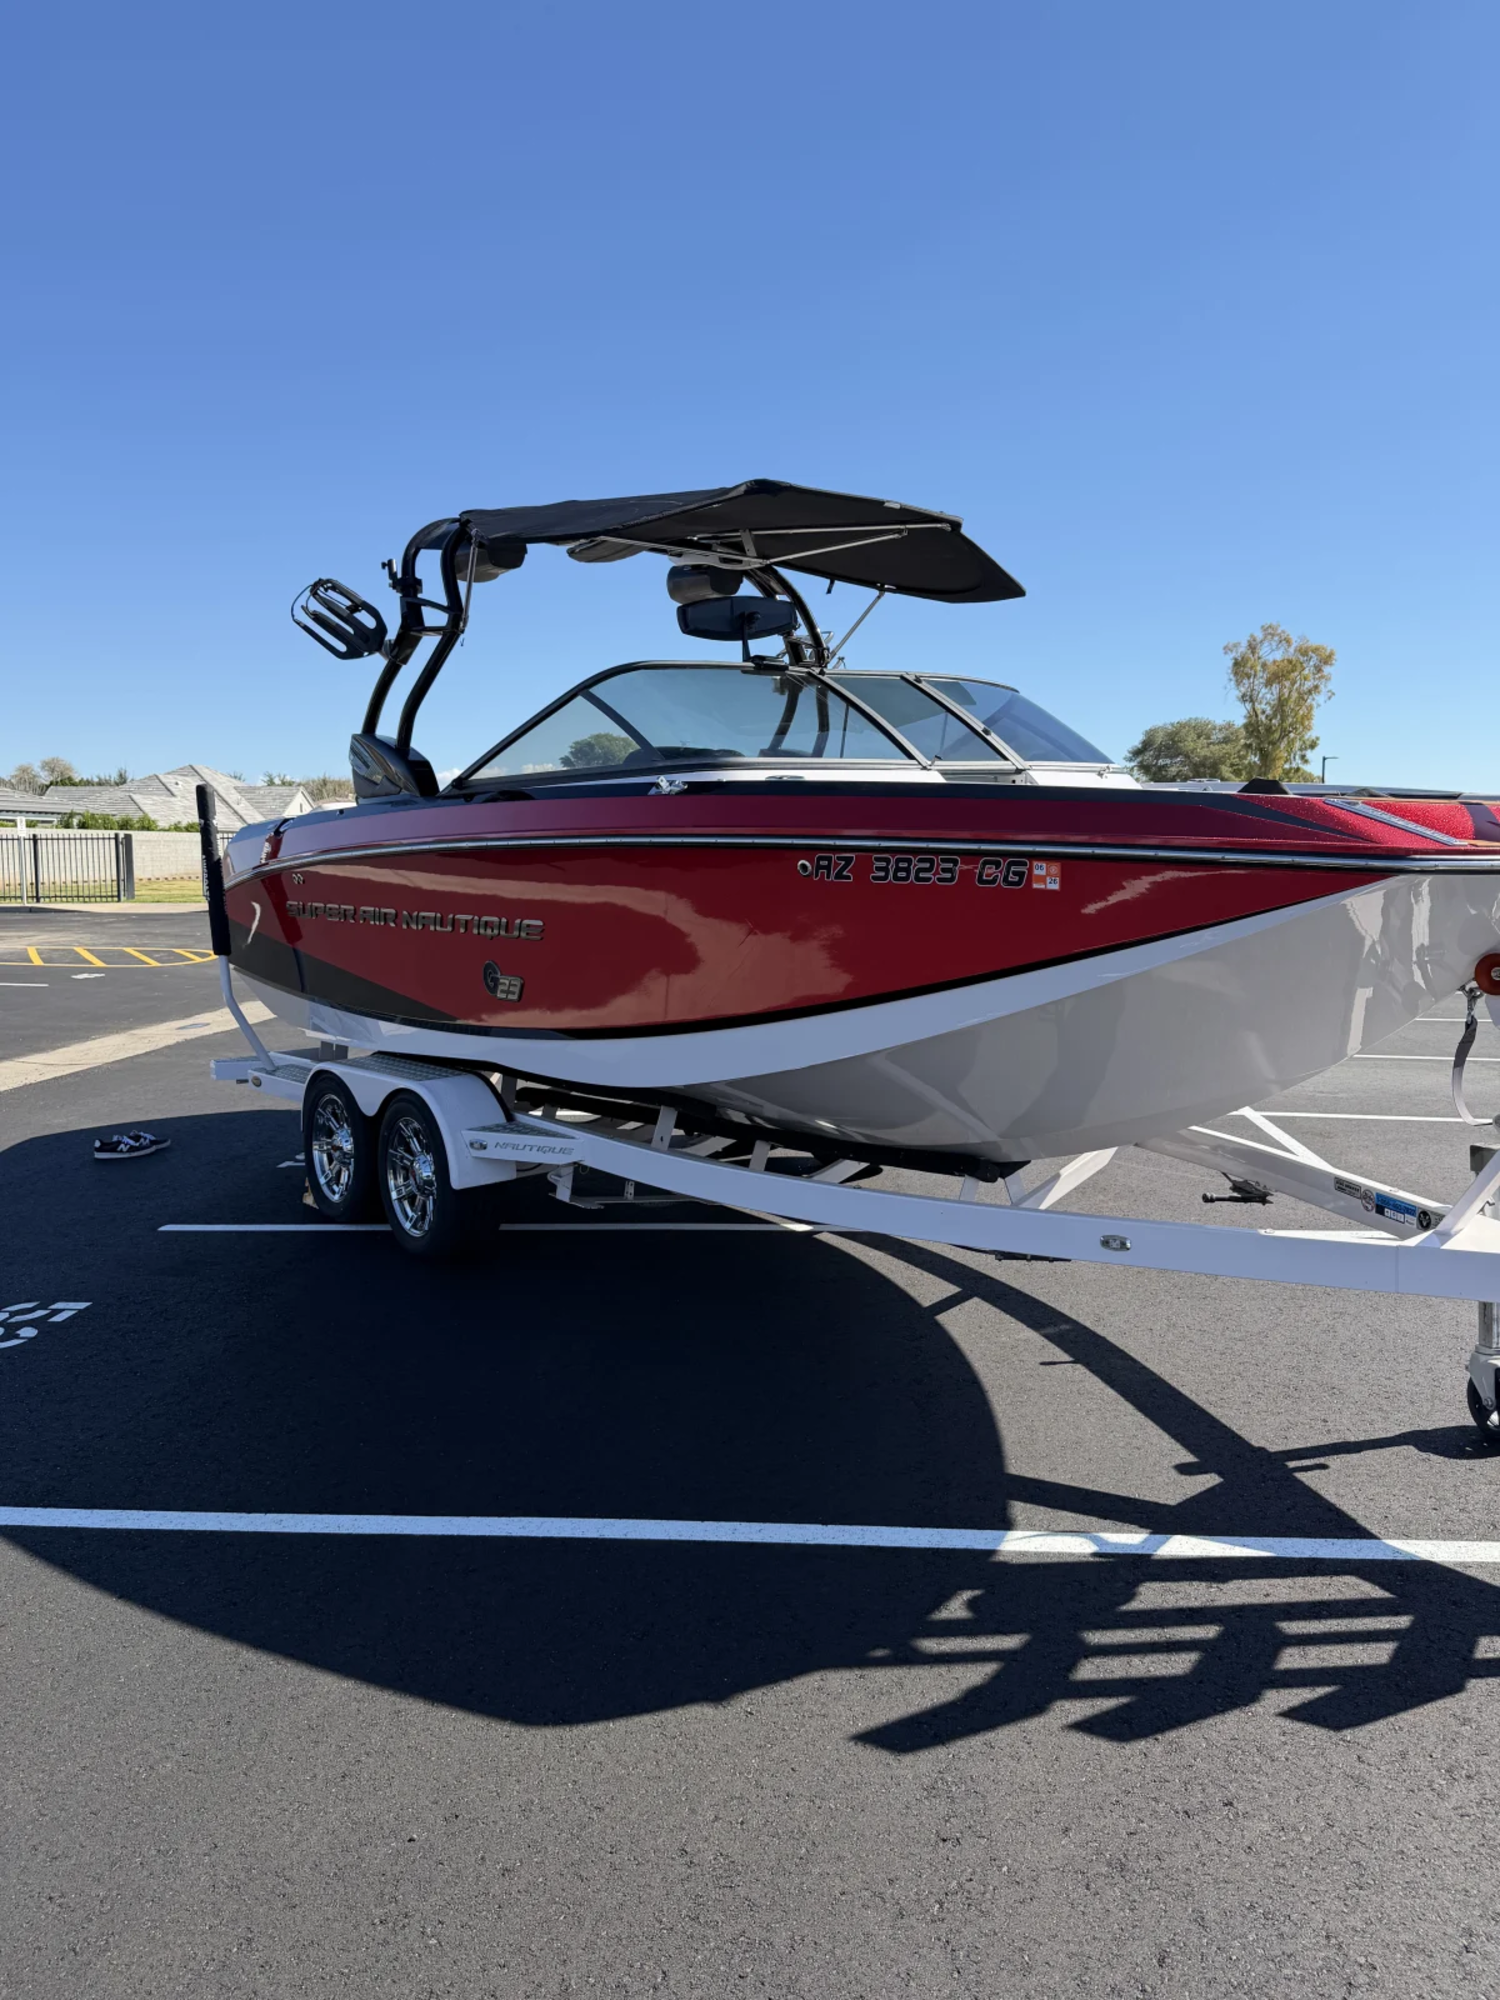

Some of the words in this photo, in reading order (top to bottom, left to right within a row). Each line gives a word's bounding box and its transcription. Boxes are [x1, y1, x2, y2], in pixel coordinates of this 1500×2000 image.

[813, 854, 855, 881] AZ
[870, 855, 960, 884] 3823
[975, 858, 1029, 888] CG
[286, 900, 355, 923] SUPER
[359, 906, 397, 927] AIR
[401, 910, 545, 941] NAUTIQUE
[494, 1141, 575, 1156] NAUTIQUE
